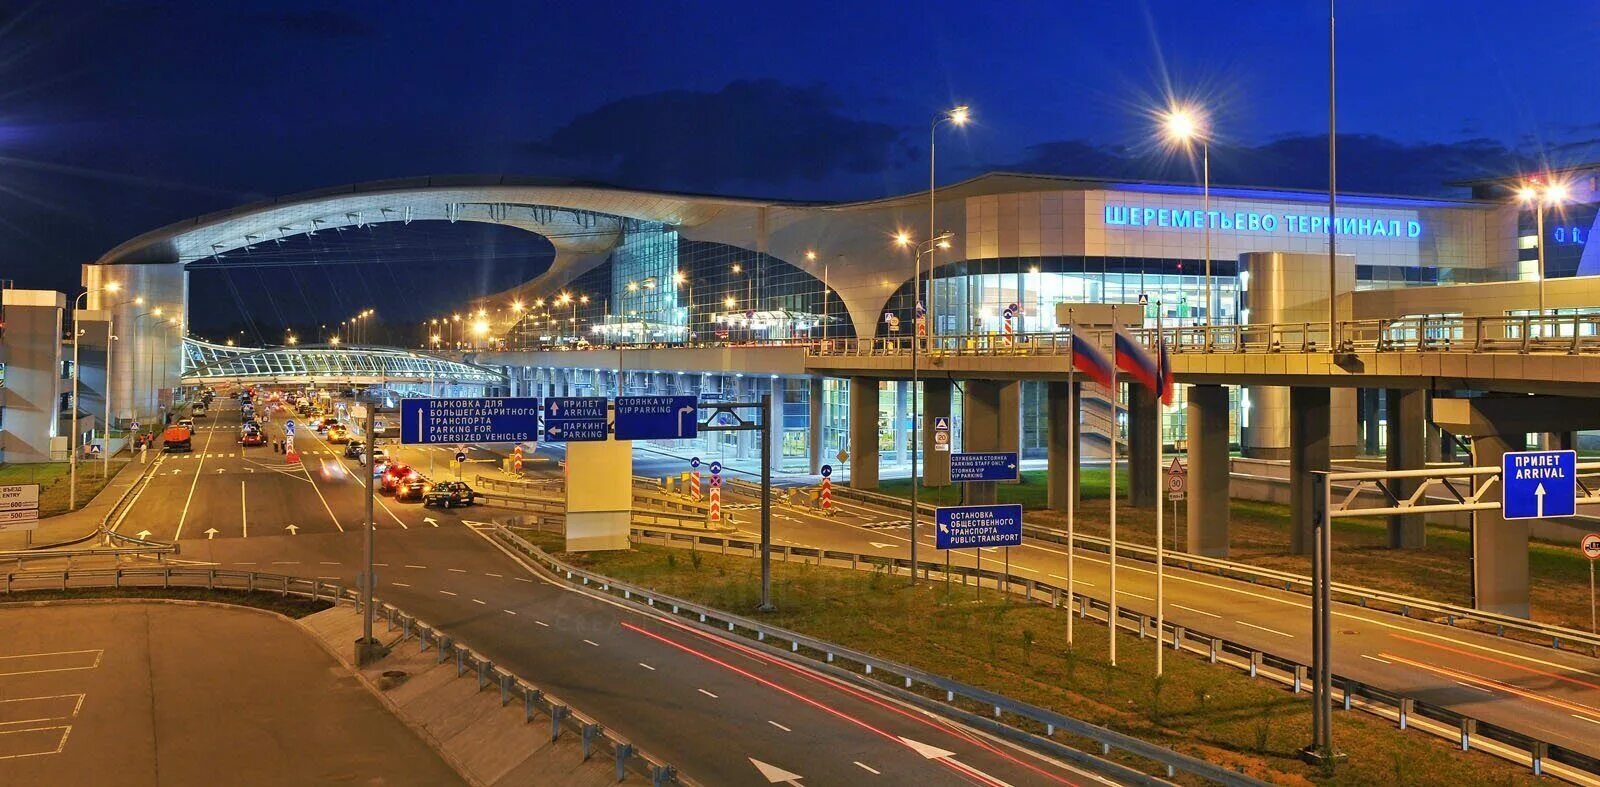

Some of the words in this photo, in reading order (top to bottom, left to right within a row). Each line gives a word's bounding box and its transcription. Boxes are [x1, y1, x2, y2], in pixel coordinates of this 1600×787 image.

[1105, 205, 1278, 232] ШЕРЕМЕТЬЕВО
[1284, 214, 1401, 237] ТЕРМИНАЛ
[1407, 219, 1421, 239] D
[430, 400, 481, 409] ПАРКОВКА
[484, 400, 503, 408] ДЛЯ
[563, 400, 599, 408] ПРИЛЕТ
[430, 408, 535, 417] БОЛЬШЕГАБАРИТНОГО
[634, 406, 671, 414] PARKING
[430, 417, 492, 426] ТРАНСПОРТА
[563, 422, 605, 430] ПАРКИНГ
[430, 426, 471, 434] PARKING
[430, 434, 482, 442] OVERSIZED
[485, 433, 528, 441] VEHICLES
[563, 431, 602, 439] PARKING
[1515, 455, 1560, 467] ПРИЛЕТ
[1515, 468, 1565, 480] ARRIVAL
[950, 512, 994, 520] ОСТАНОВКА
[950, 518, 1014, 528] ОБЩЕСТВЕННОГО
[950, 527, 998, 536] ТРАНСПОРТА
[978, 534, 1018, 542] TRANSPORT
